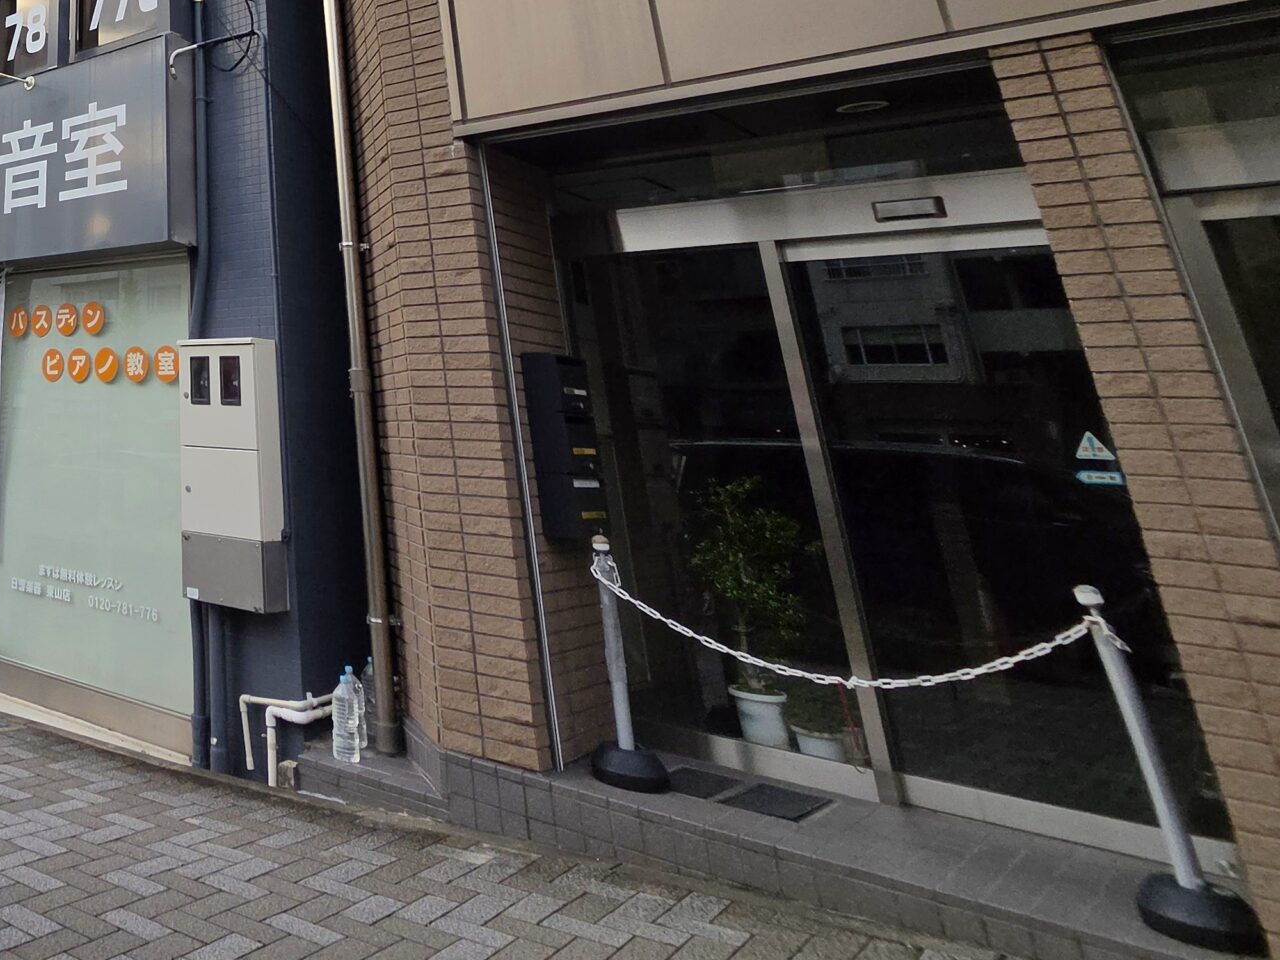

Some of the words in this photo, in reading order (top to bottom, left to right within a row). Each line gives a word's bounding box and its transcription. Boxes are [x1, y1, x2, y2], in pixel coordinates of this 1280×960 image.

[10, 307, 102, 332] バスティン
[46, 350, 177, 377] ピアノ教室
[38, 564, 124, 591] まずは無料体験レッスン
[46, 585, 71, 602] 東山店
[88, 595, 159, 622] 0120-781-776
